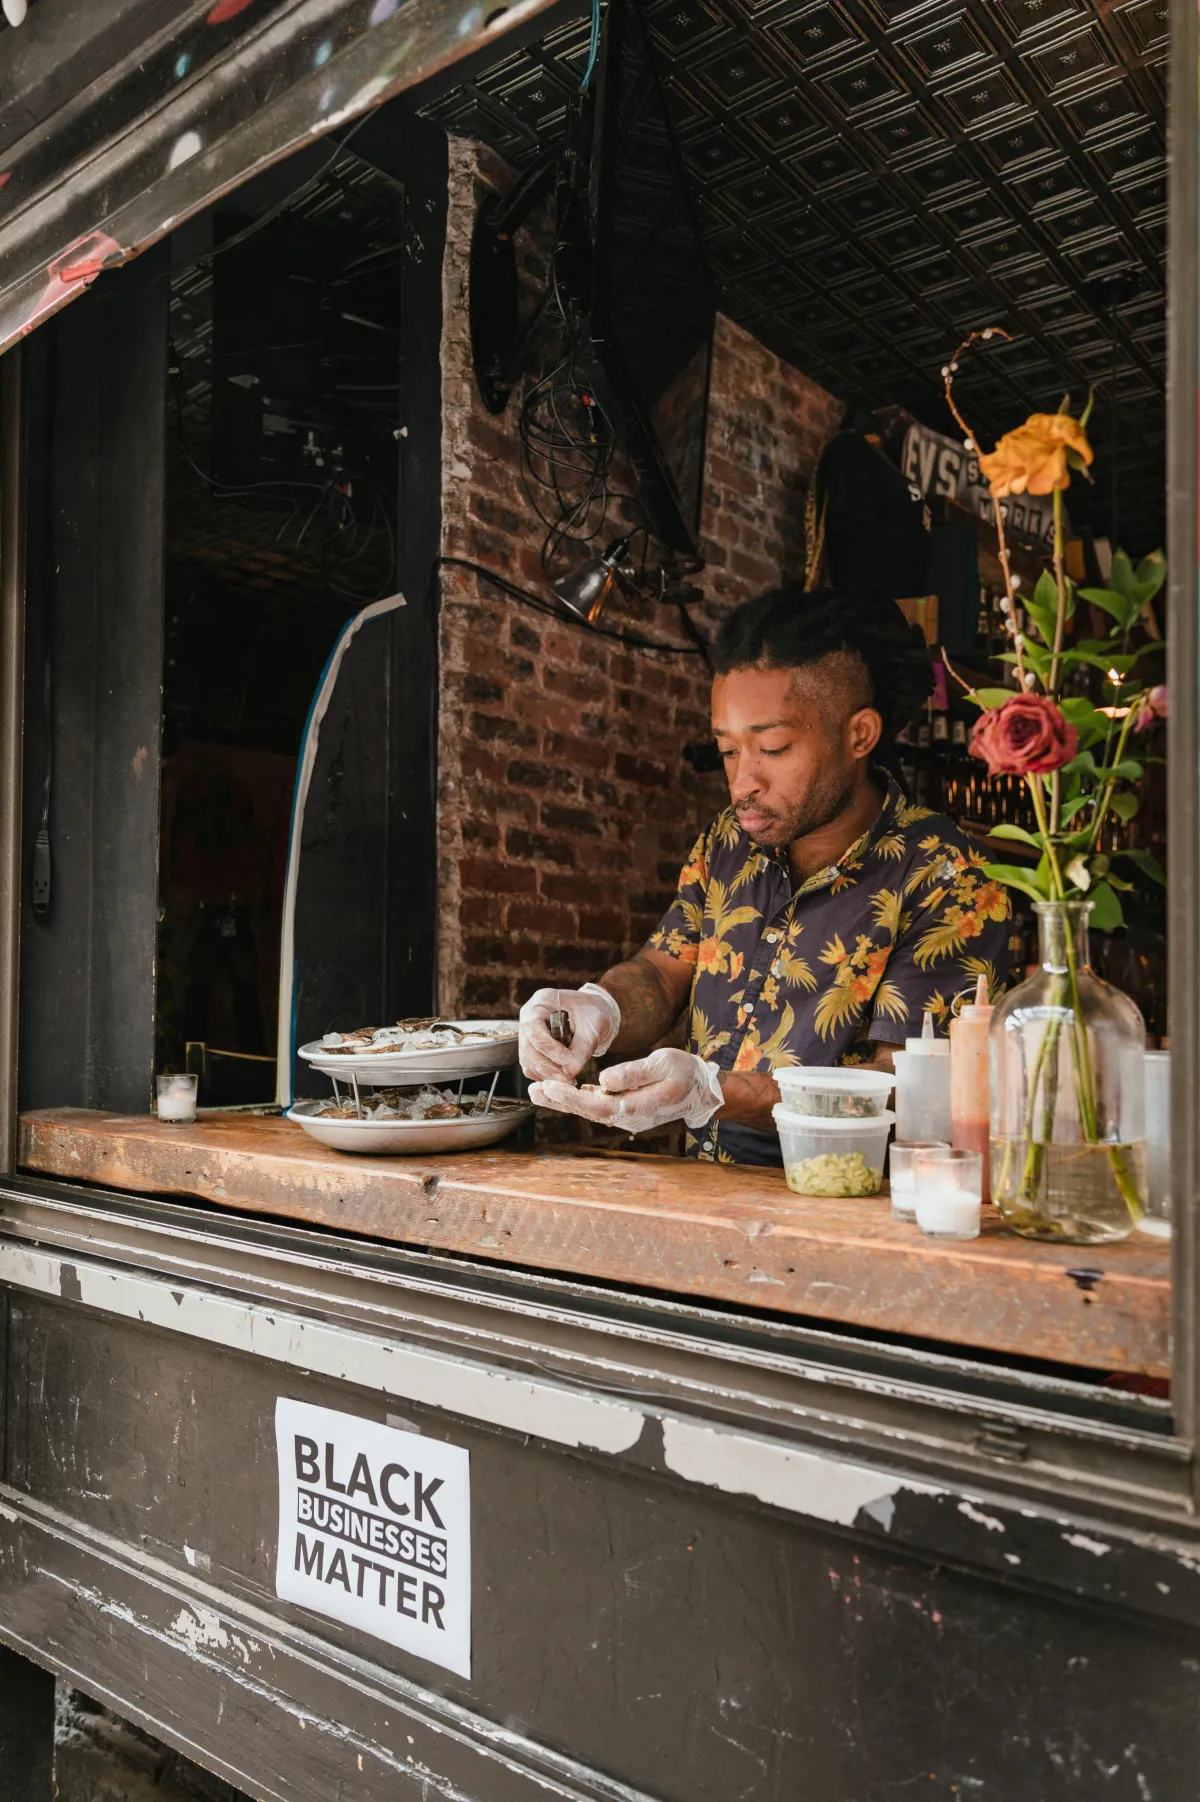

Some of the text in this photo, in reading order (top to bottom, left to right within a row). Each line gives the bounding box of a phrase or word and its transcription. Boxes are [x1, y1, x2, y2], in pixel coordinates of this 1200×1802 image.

[294, 1434, 447, 1531] BLACK
[297, 1491, 447, 1573] BUSINESSES
[294, 1531, 446, 1631] MATTER
